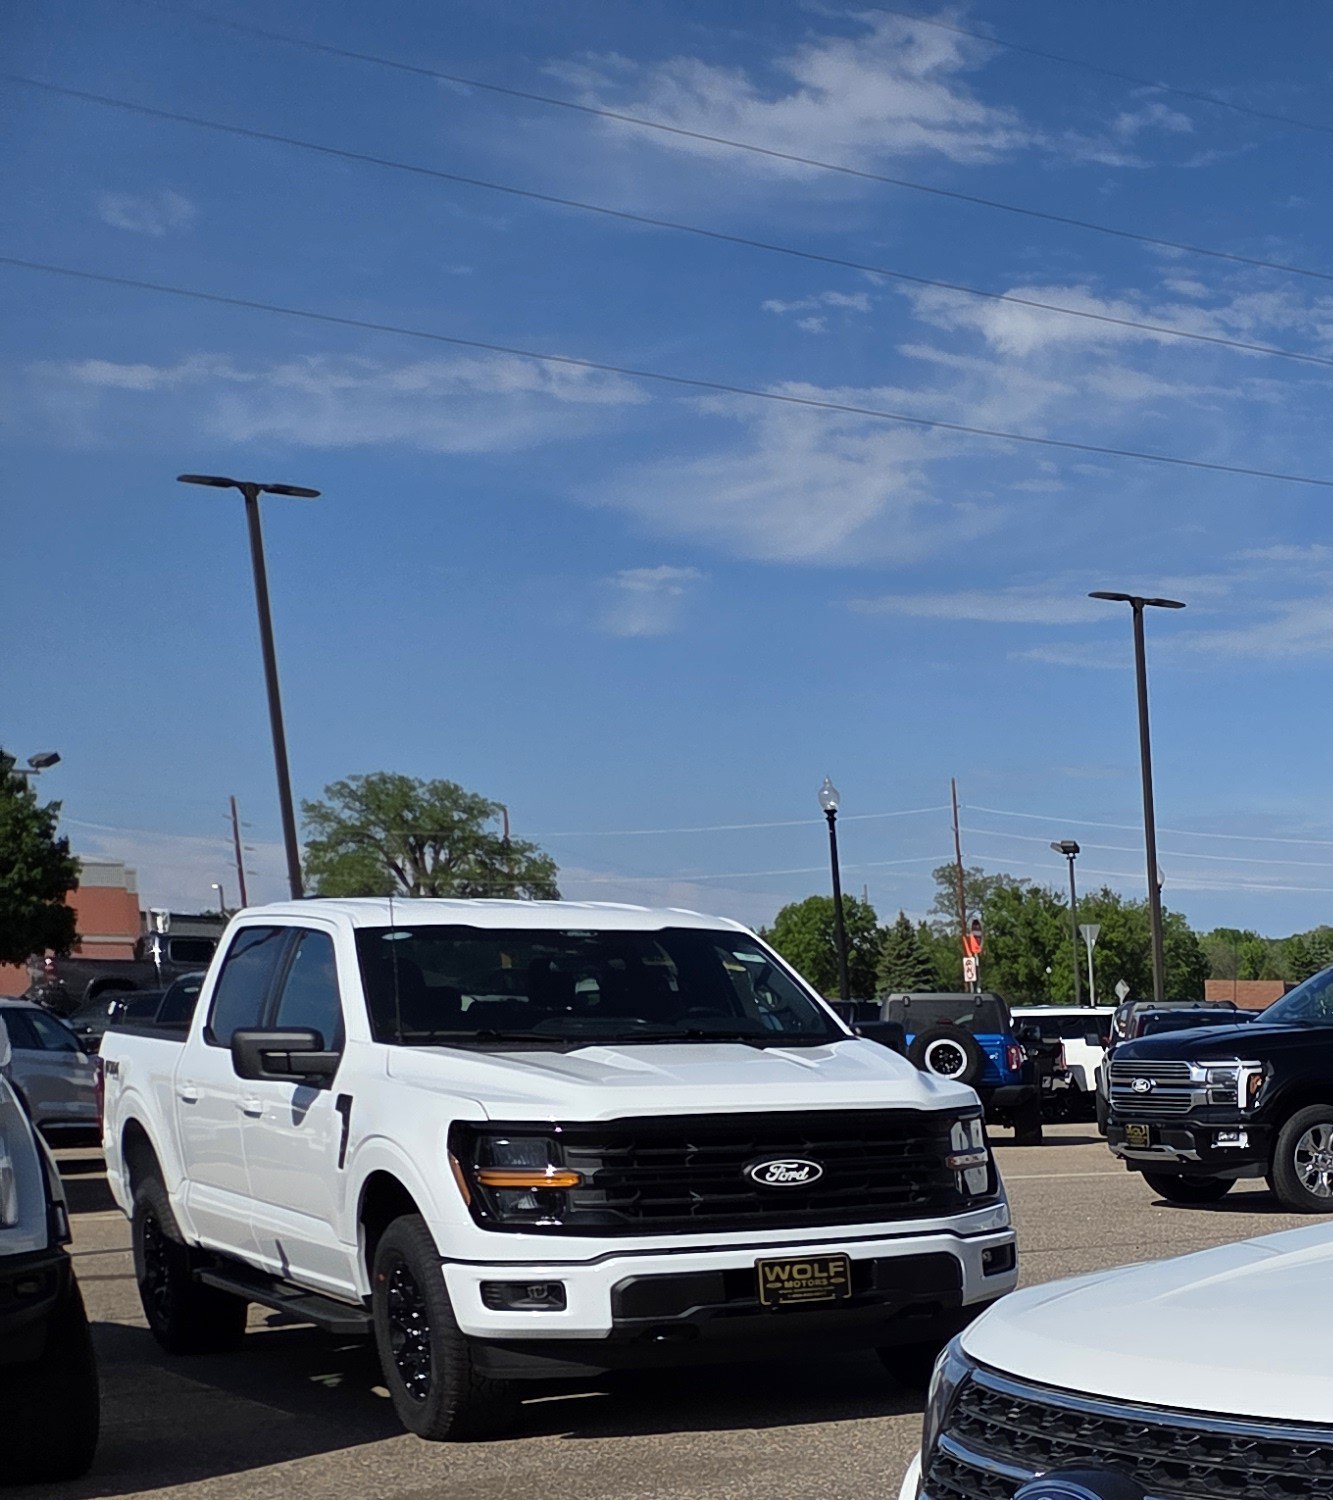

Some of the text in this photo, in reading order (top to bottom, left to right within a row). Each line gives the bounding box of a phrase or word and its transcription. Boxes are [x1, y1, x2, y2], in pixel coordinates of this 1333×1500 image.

[765, 1163, 810, 1182] Ford
[764, 1261, 844, 1281] WOLF
[783, 1278, 828, 1289] MOTORS
